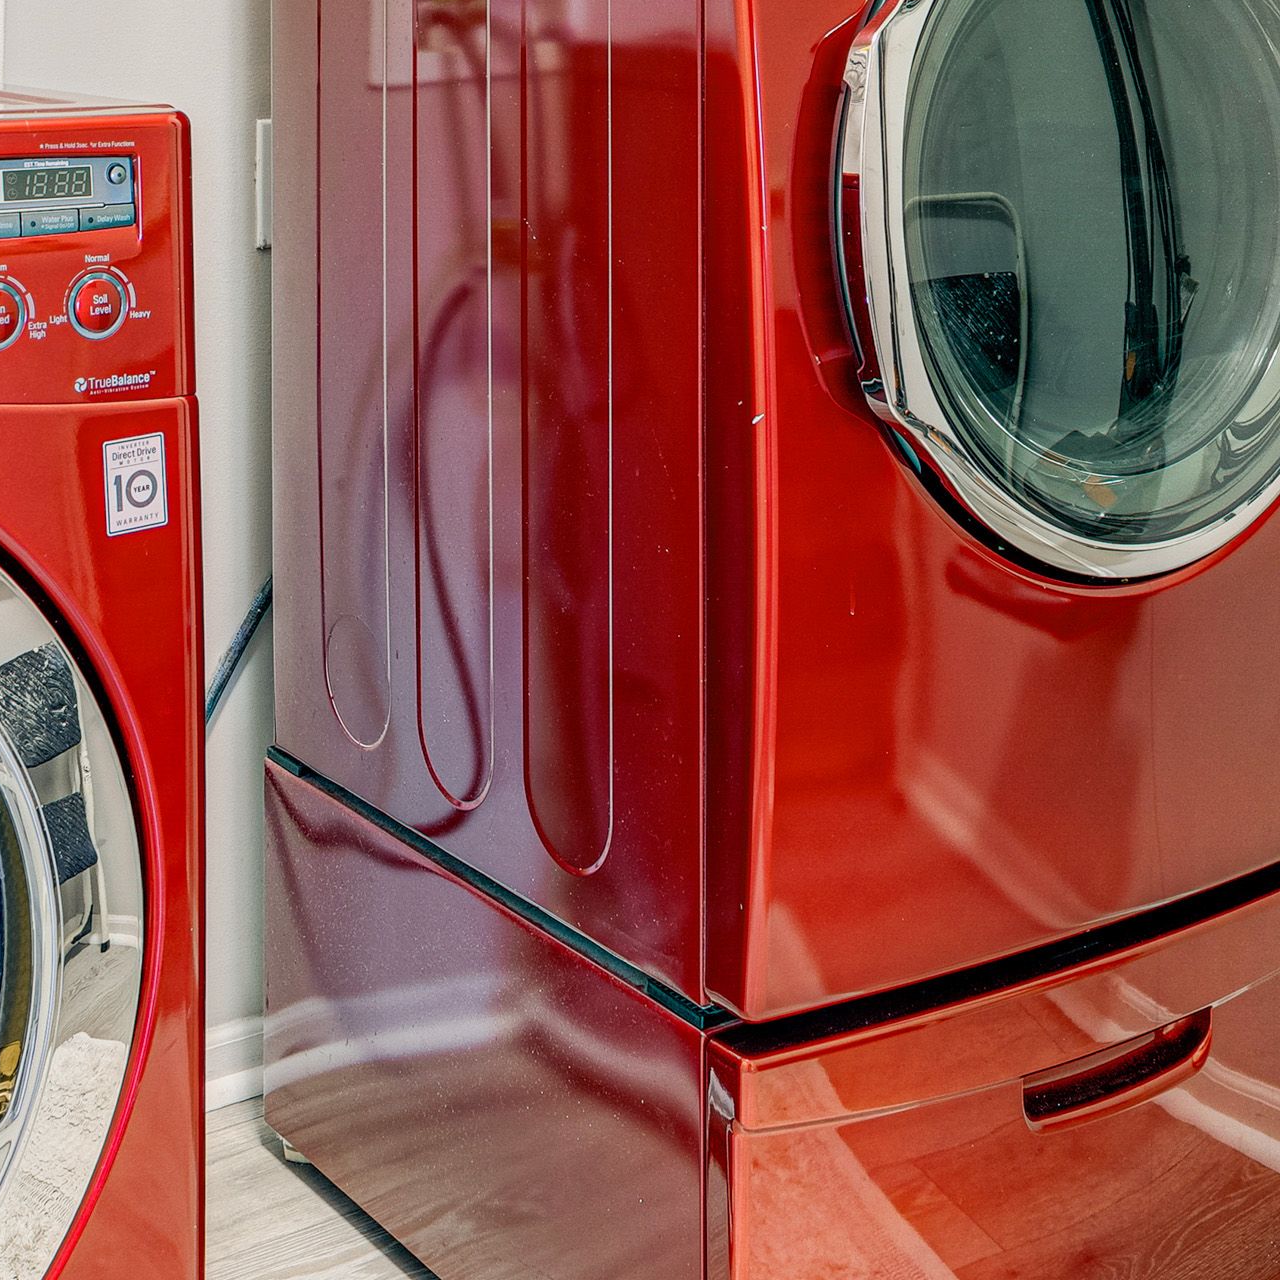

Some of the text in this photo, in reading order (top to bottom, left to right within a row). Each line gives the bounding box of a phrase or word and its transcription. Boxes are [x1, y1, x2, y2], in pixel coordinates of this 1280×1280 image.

[97, 214, 131, 224] Delay Wash
[84, 253, 110, 263] Normal
[92, 294, 109, 305] Soil
[89, 305, 112, 316] Level
[129, 309, 151, 319] Heavy
[28, 321, 48, 330] Extra
[49, 315, 68, 326] Light
[29, 330, 47, 341] High
[118, 440, 149, 450] INVERTER
[111, 446, 157, 462] Direct Drive
[113, 469, 158, 513] 10
[133, 484, 150, 494] YEAR
[115, 511, 160, 527] WARRANTY
